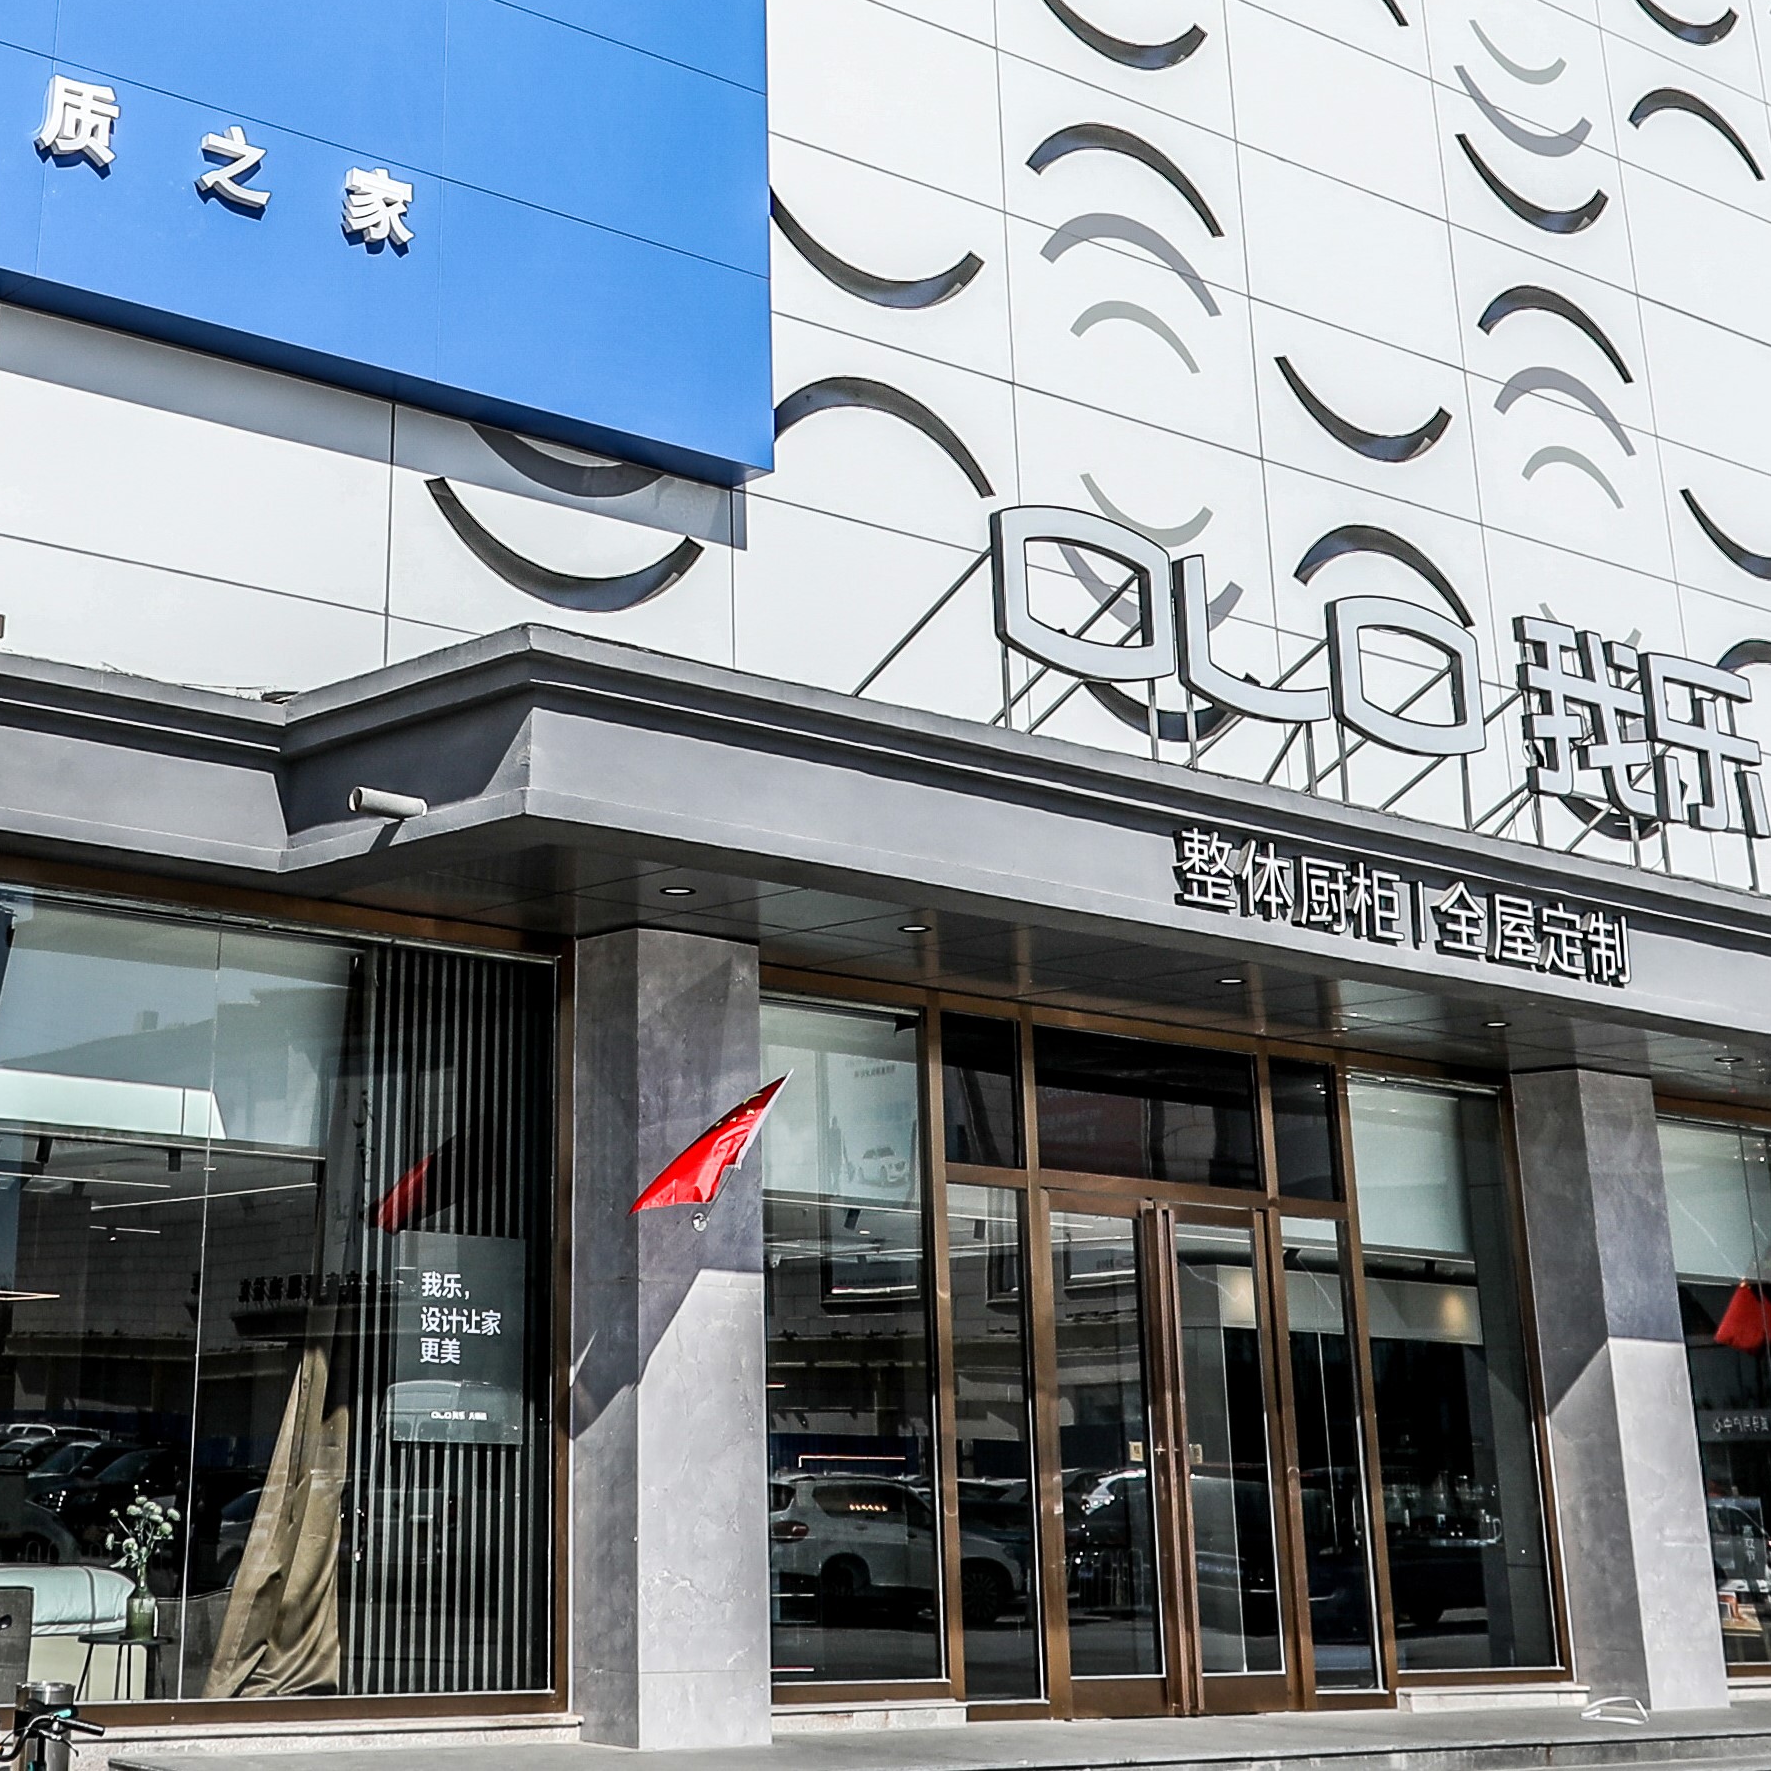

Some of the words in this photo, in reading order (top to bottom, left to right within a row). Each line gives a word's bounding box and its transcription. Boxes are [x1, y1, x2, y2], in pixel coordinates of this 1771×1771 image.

[420, 1307, 501, 1336] 设计让家
[420, 1338, 461, 1365] 更美
